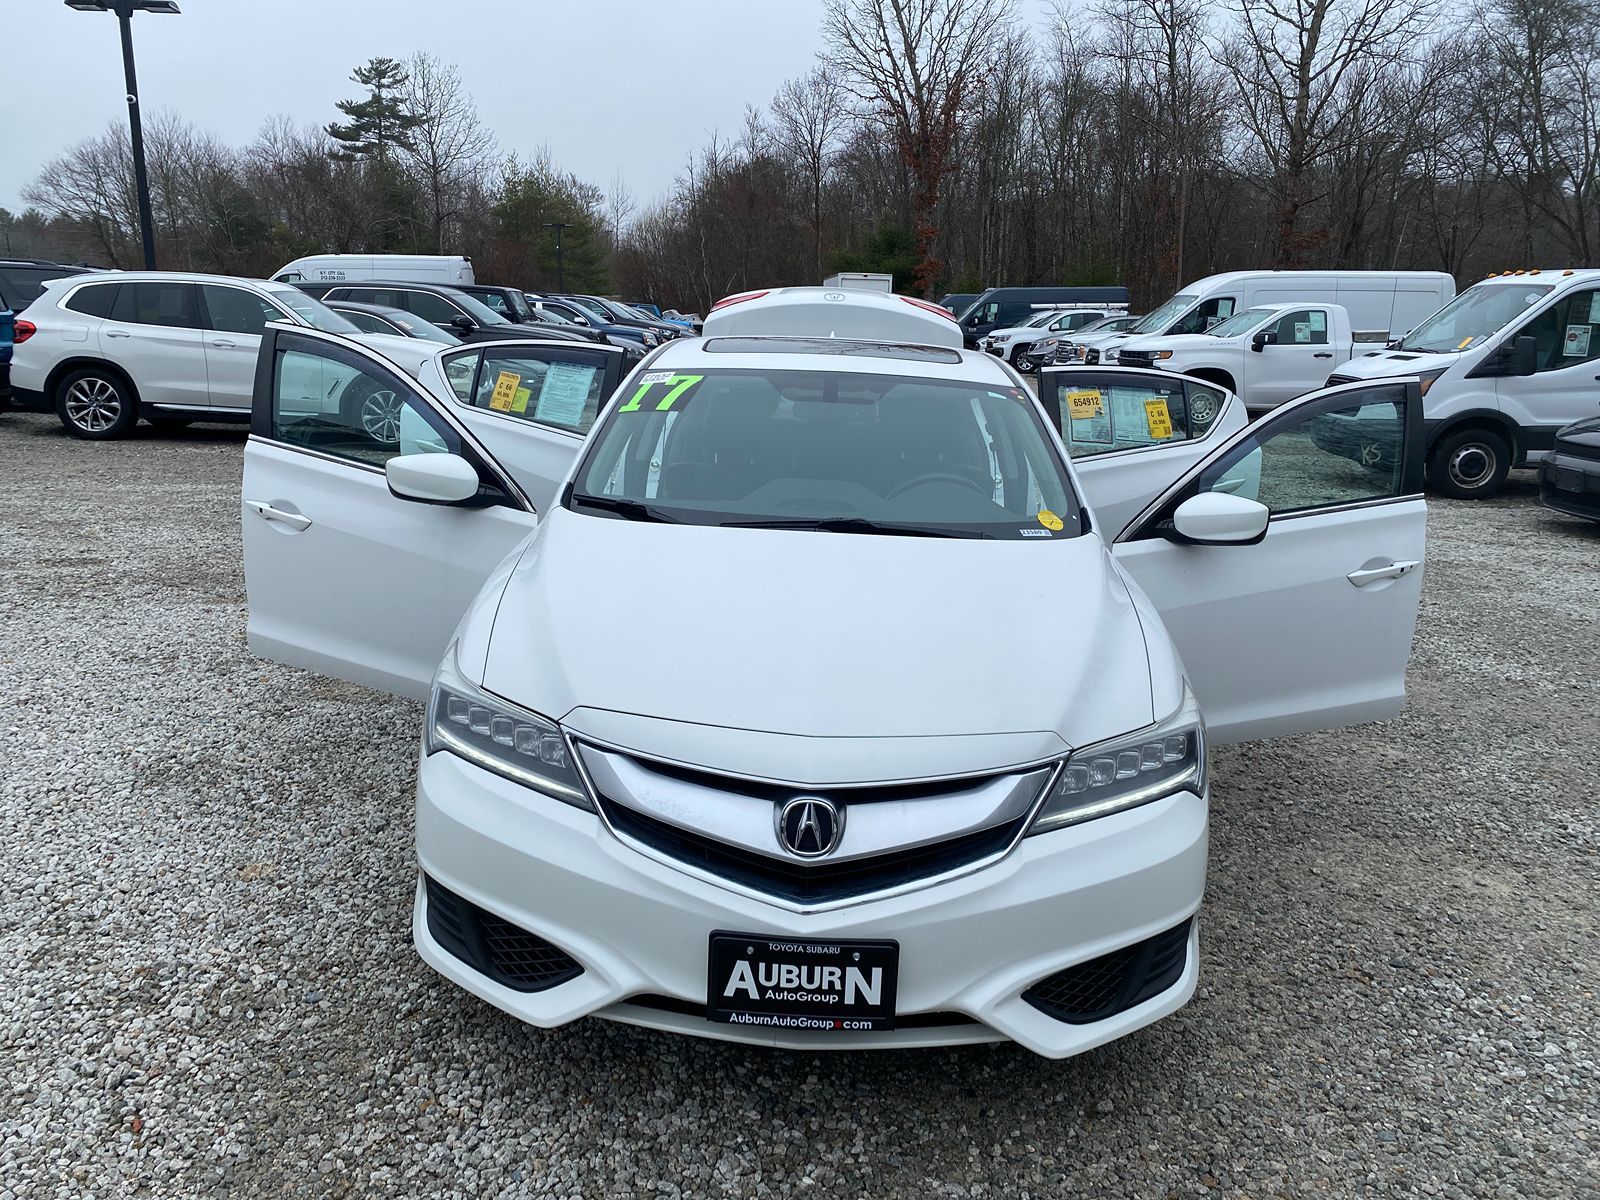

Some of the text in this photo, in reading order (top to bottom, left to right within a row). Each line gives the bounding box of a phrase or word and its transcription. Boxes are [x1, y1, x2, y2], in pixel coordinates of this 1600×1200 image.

[618, 375, 704, 412] 17
[1073, 396, 1100, 407] 654912
[768, 943, 841, 954] TOYOTA SUBARU
[723, 959, 883, 1006] AUBURN
[765, 989, 839, 1005] AutoGroup
